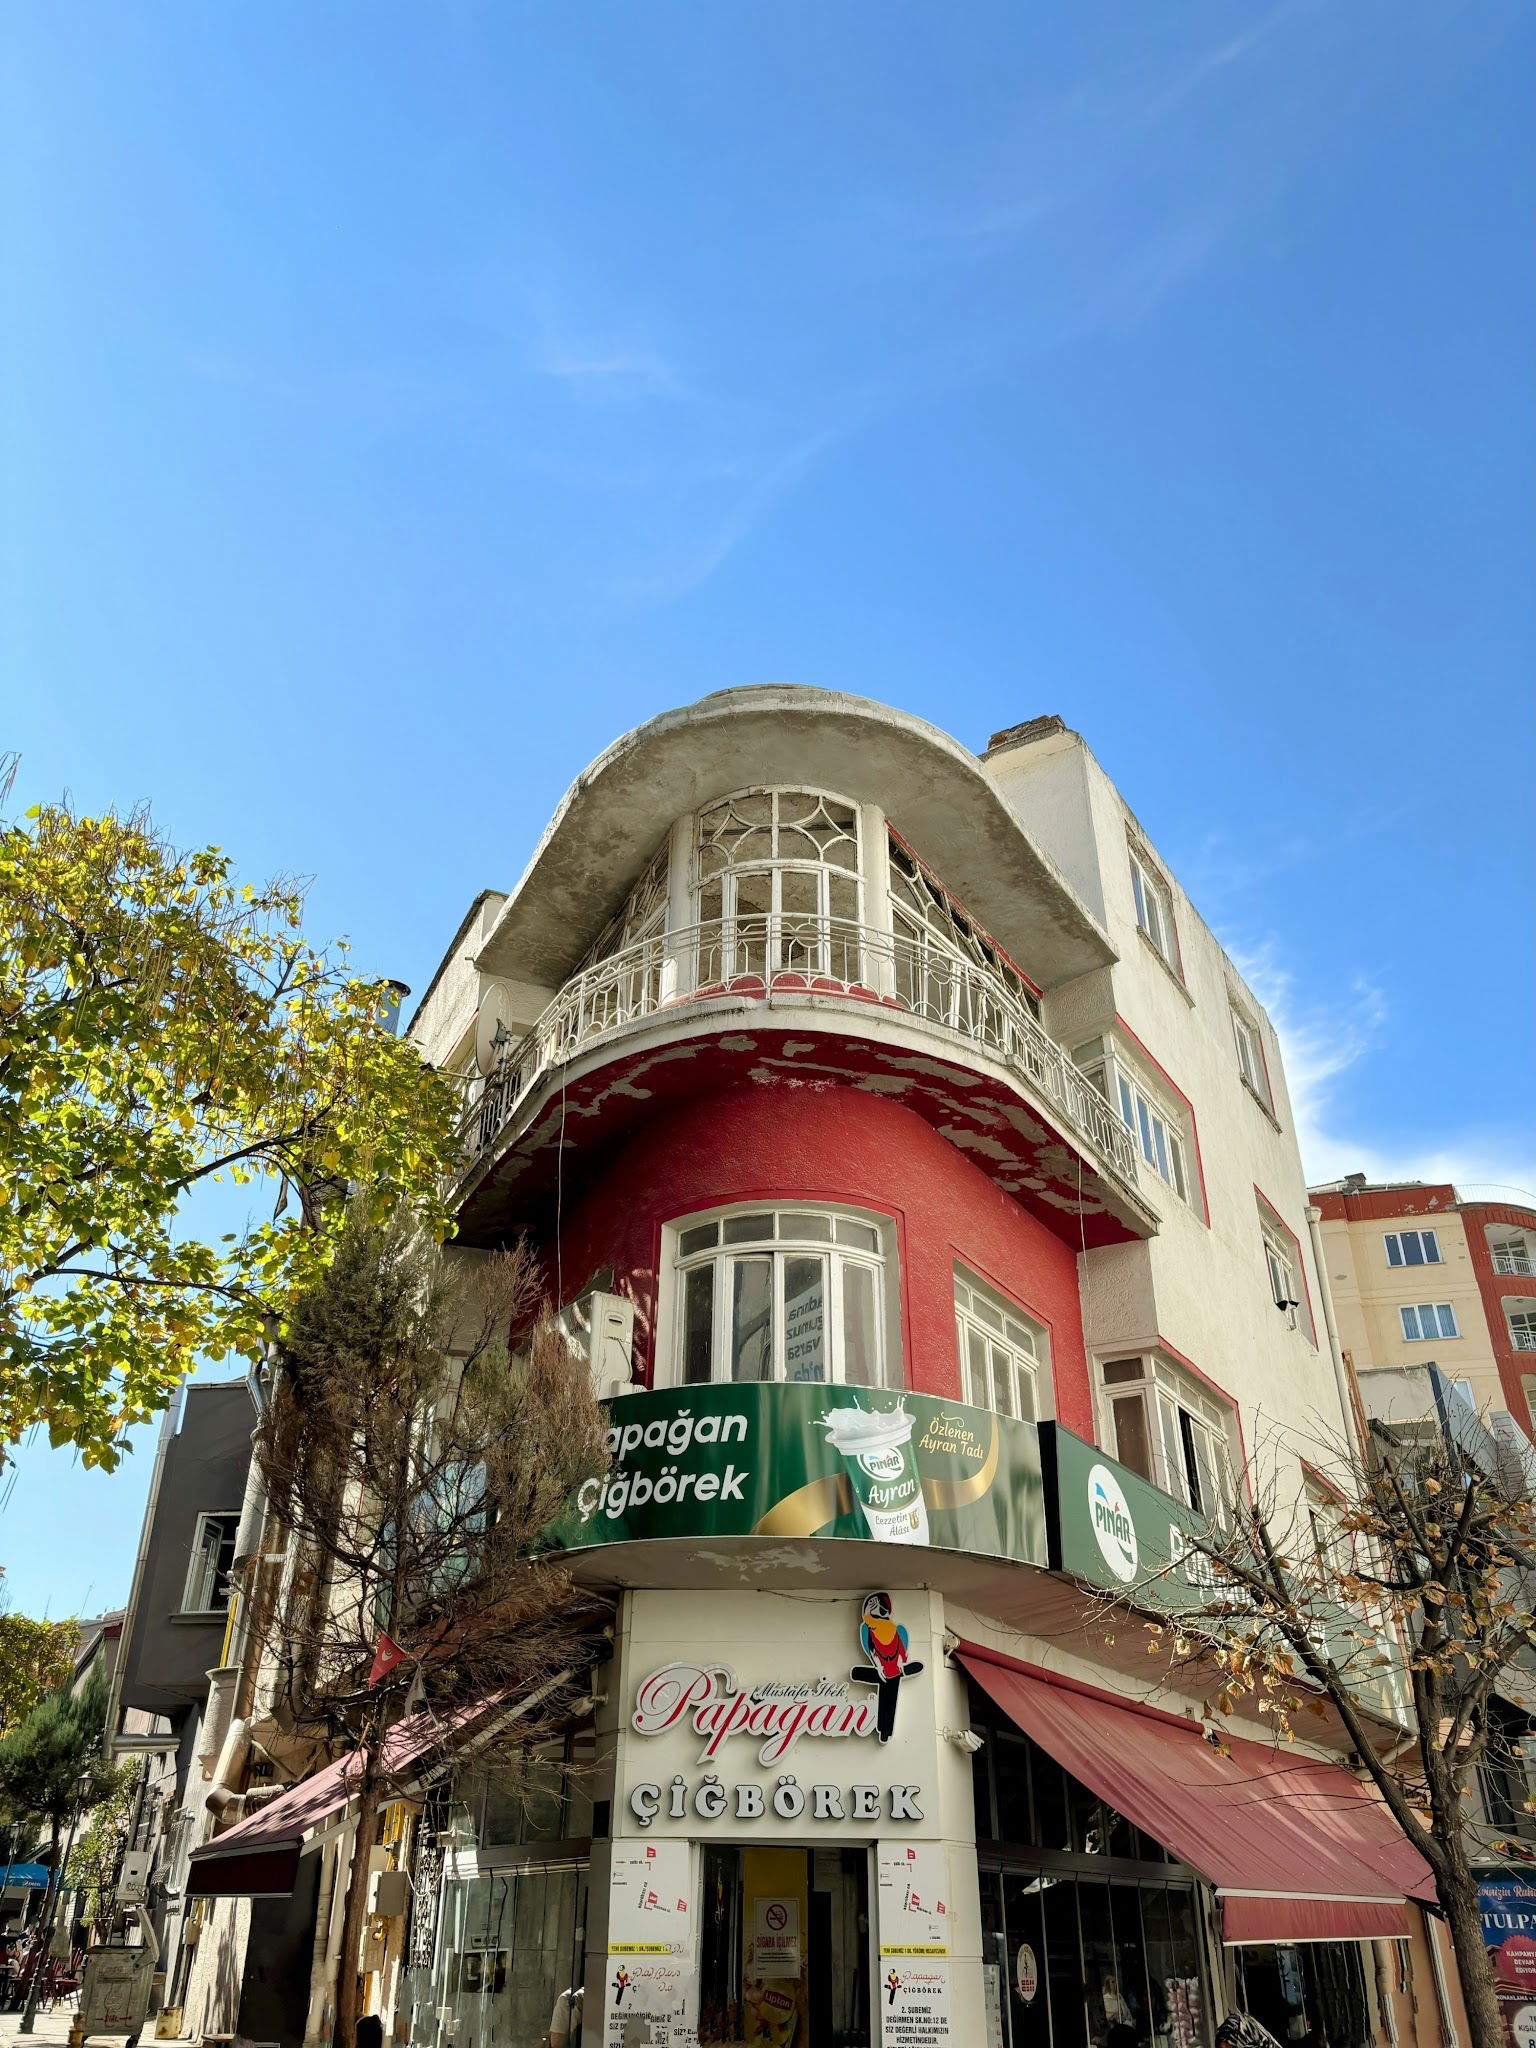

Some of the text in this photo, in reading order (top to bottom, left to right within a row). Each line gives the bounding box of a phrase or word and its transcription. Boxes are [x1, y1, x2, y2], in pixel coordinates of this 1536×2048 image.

[606, 1409, 748, 1461] apağan
[929, 1417, 975, 1443] Özlenen
[919, 1434, 984, 1459] Ayran Tadı
[577, 1464, 750, 1523] Çiğbörek
[868, 1478, 916, 1509] Ayran
[875, 1513, 909, 1526] Lezzetin
[756, 1682, 809, 1700] Mustafa
[635, 1666, 876, 1763] Papağan
[630, 1774, 925, 1828] ÇİĞBÖREK
[765, 1992, 791, 2008] Lipton
